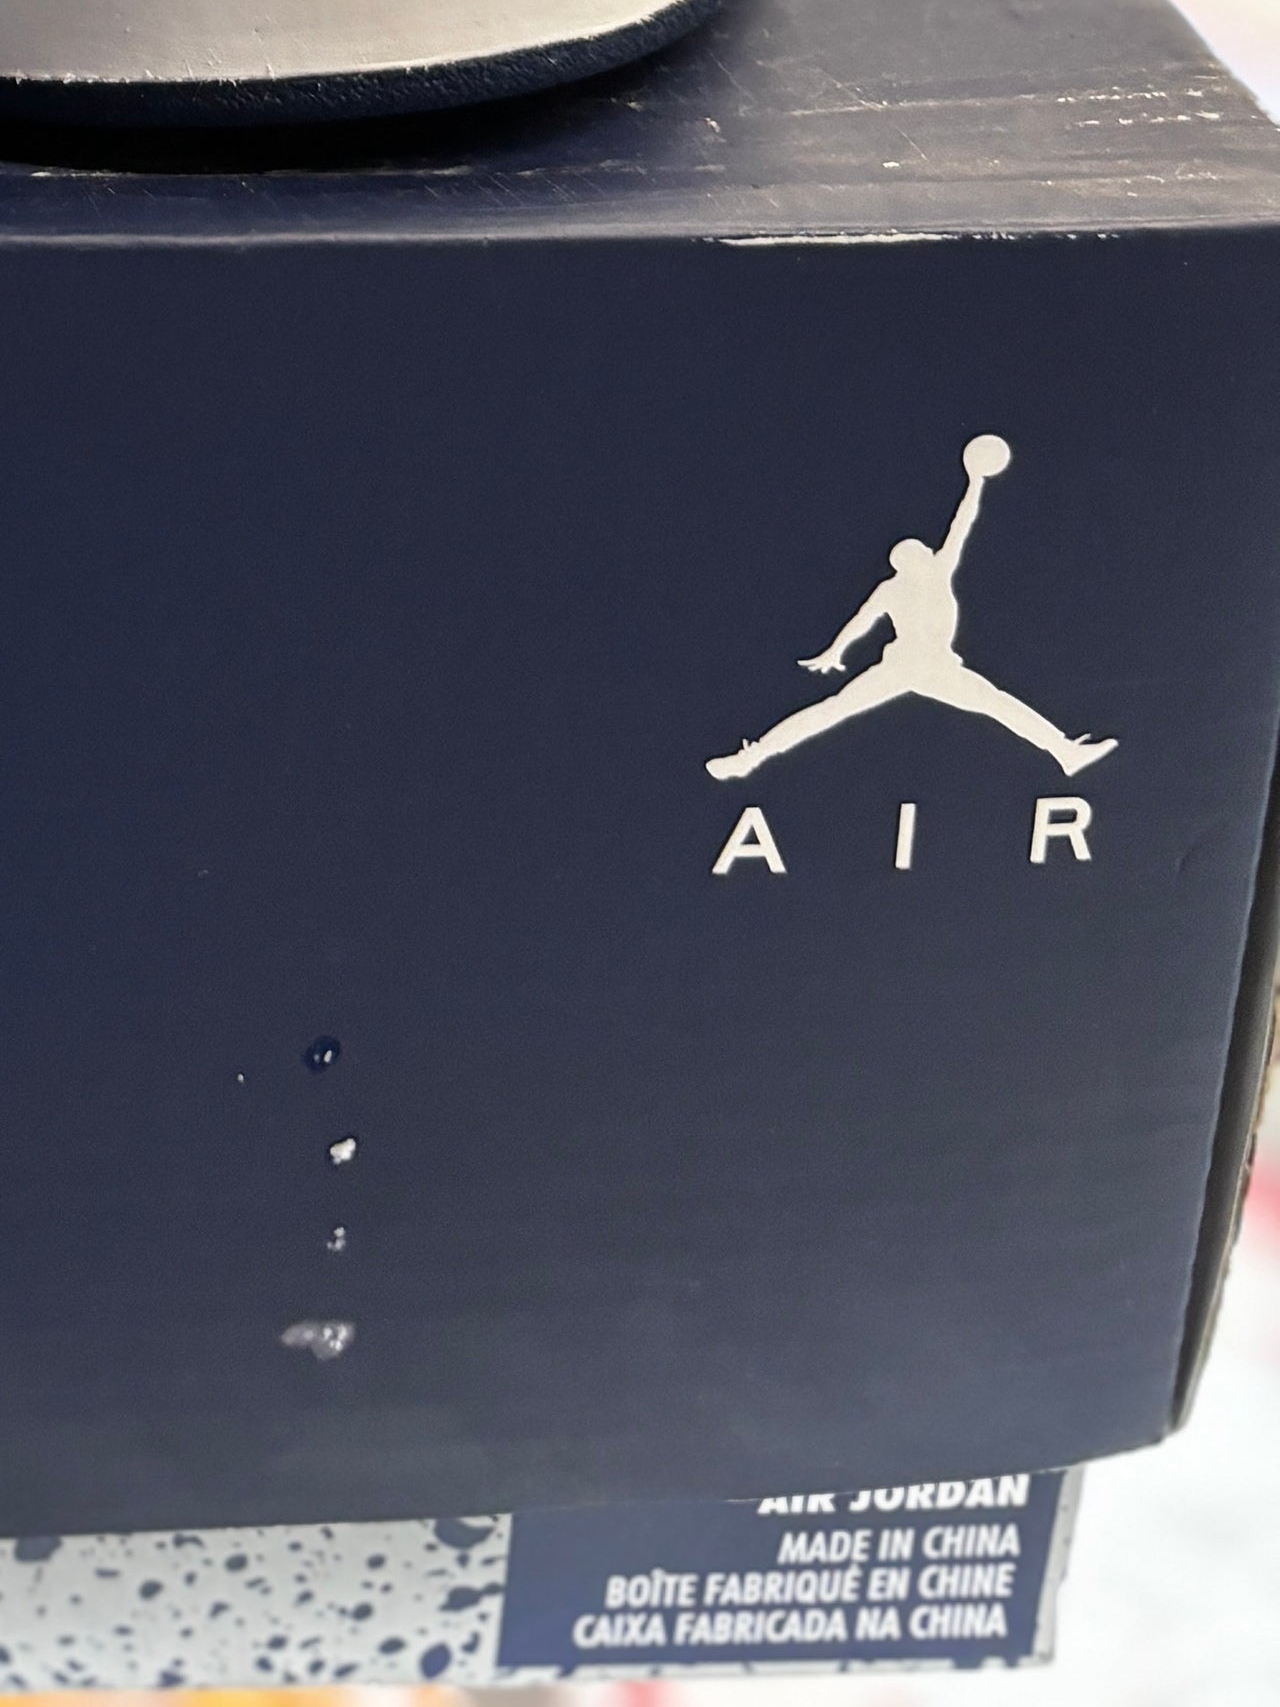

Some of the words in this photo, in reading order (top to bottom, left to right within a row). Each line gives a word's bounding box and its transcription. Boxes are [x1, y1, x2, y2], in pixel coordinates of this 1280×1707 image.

[711, 796, 1092, 875] AIR
[848, 1473, 1030, 1511] JORDAN
[777, 1529, 873, 1564] MADE
[877, 1528, 915, 1561] IN
[921, 1523, 1020, 1560] CHINA
[604, 1568, 698, 1609] BOÎTE
[867, 1567, 910, 1601] EN
[917, 1562, 1016, 1599] CHINE
[572, 1612, 667, 1649] CAIXA
[672, 1607, 848, 1646] FABRICADA
[854, 1606, 901, 1641] NA
[908, 1602, 1007, 1639] CHINA
